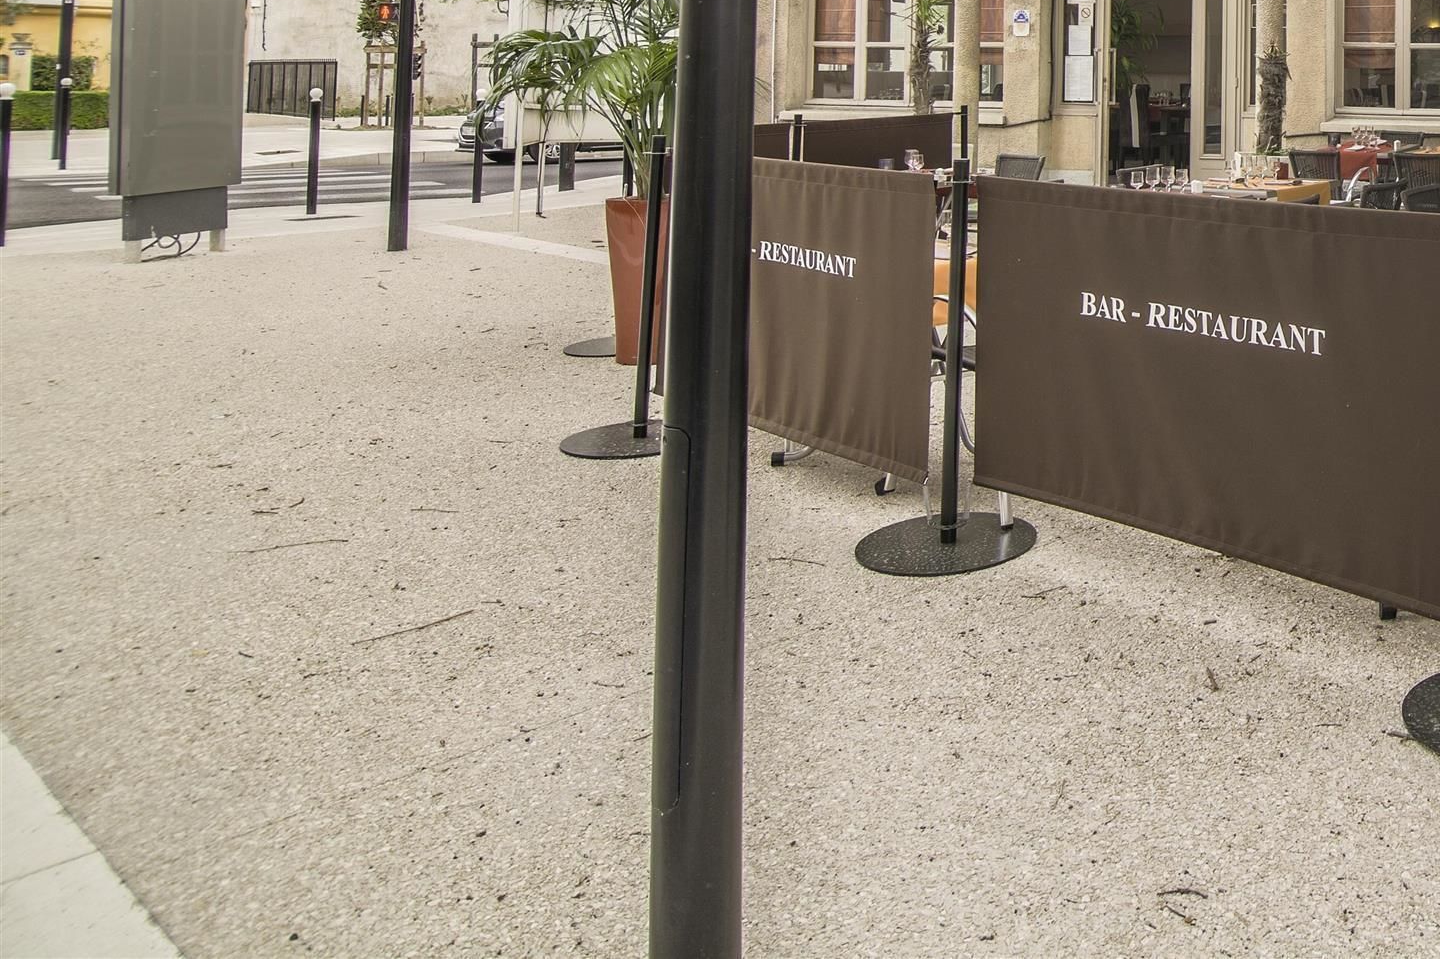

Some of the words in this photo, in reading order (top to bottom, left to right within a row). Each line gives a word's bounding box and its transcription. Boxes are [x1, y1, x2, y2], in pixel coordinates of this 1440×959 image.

[759, 241, 857, 278] RESTAURANT
[1080, 291, 1127, 323] BAR
[1145, 301, 1326, 356] RESTAURANT
